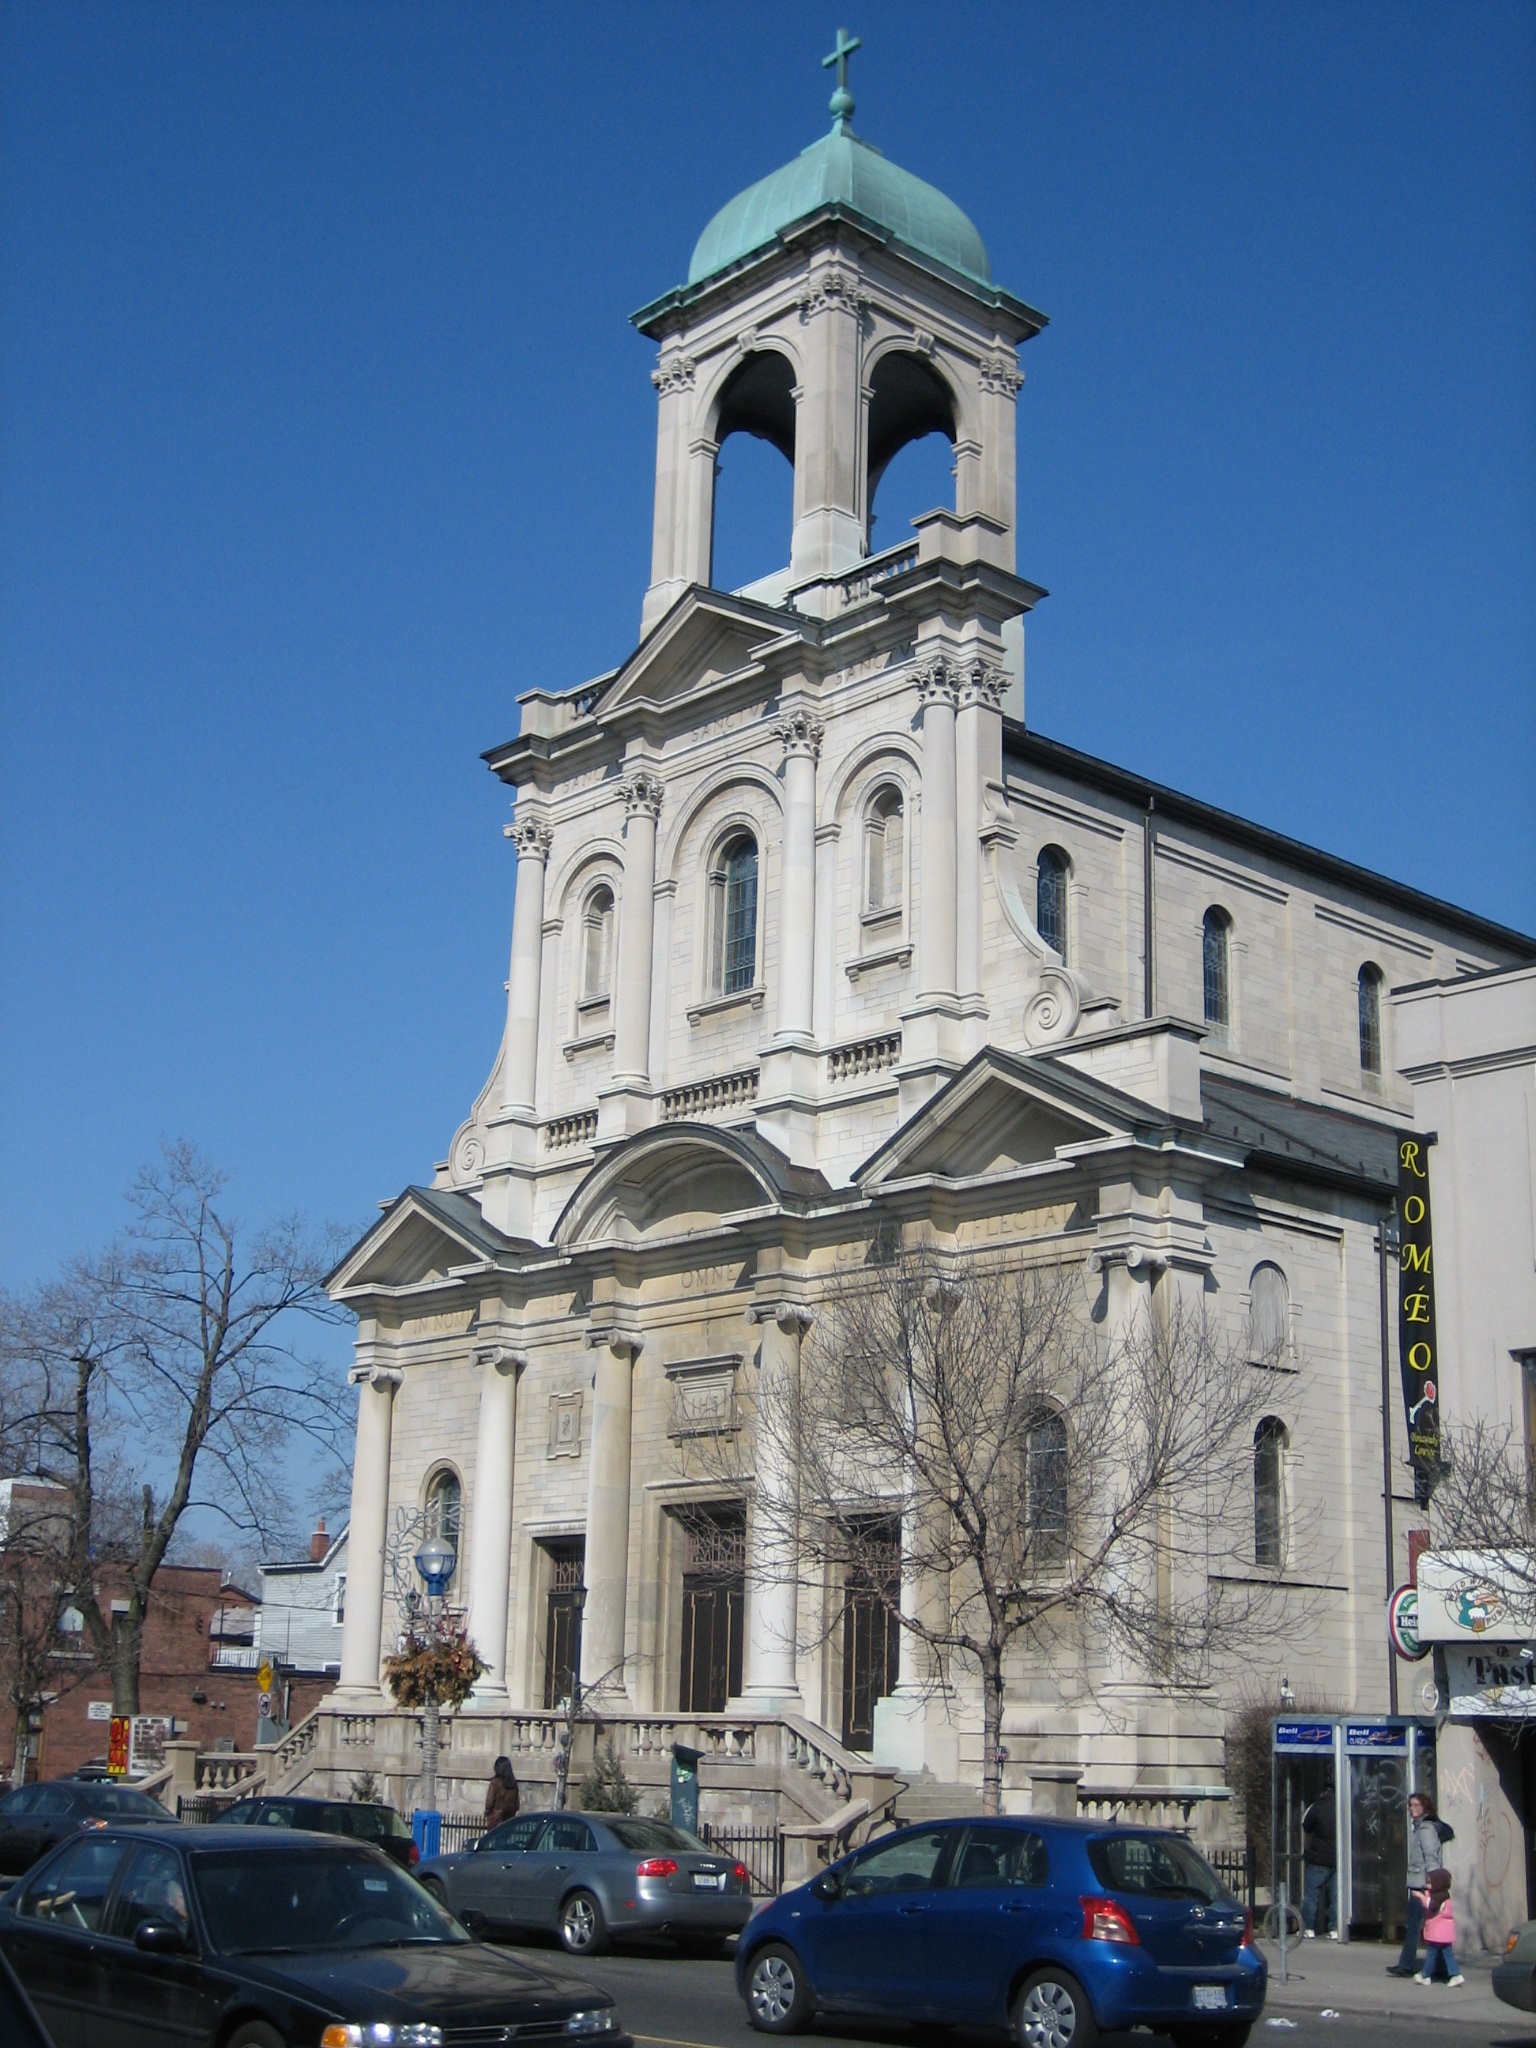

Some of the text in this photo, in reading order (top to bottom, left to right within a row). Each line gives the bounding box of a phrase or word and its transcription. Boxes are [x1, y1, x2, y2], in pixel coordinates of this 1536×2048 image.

[1400, 1141, 1431, 1371] ROMÉO
[1485, 1609, 1503, 1626] PUB
[1348, 1728, 1370, 1736] Bell
